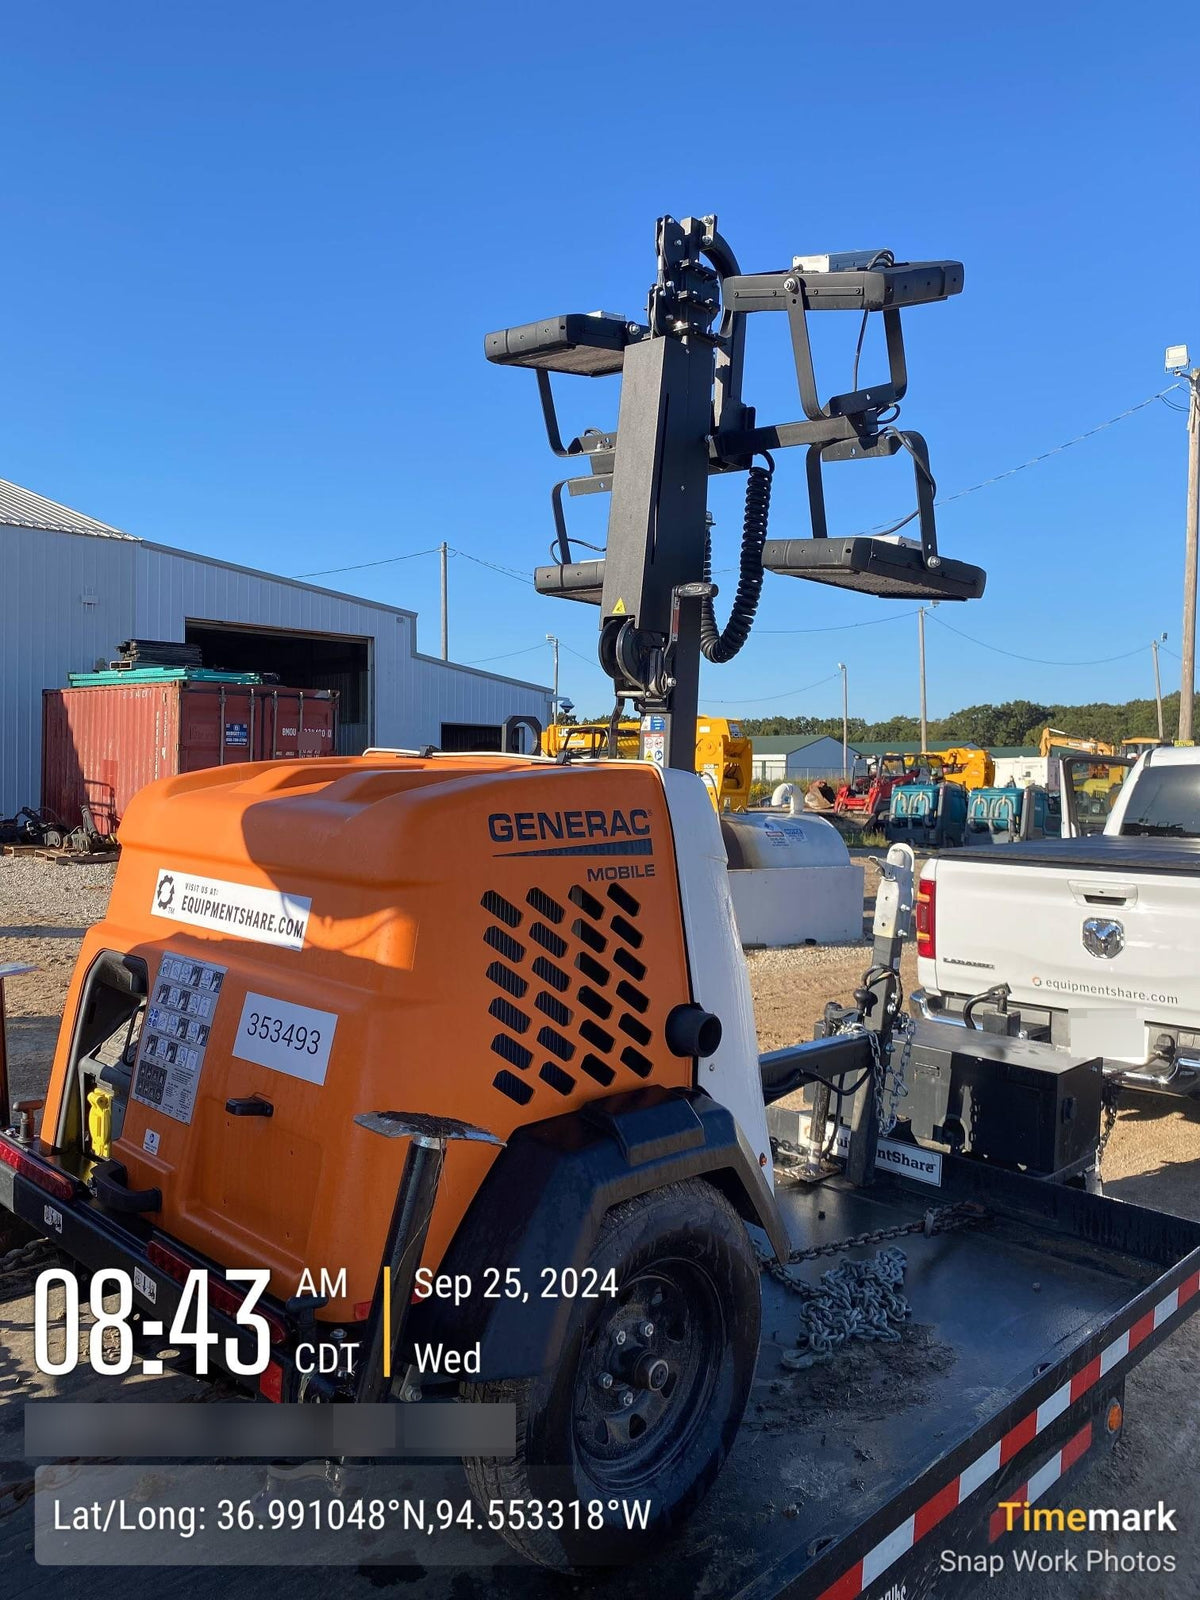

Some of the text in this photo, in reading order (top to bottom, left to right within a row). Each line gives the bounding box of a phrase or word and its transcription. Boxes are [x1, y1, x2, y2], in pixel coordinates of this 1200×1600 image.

[488, 809, 650, 842] GENERAC
[587, 864, 655, 882] MOBILE
[185, 882, 219, 896] VISIT US AT:
[181, 895, 304, 938] EQUIPMENTSHARE.COM
[1046, 979, 1178, 1004] equipmentshare.com
[246, 1012, 321, 1055] 353493
